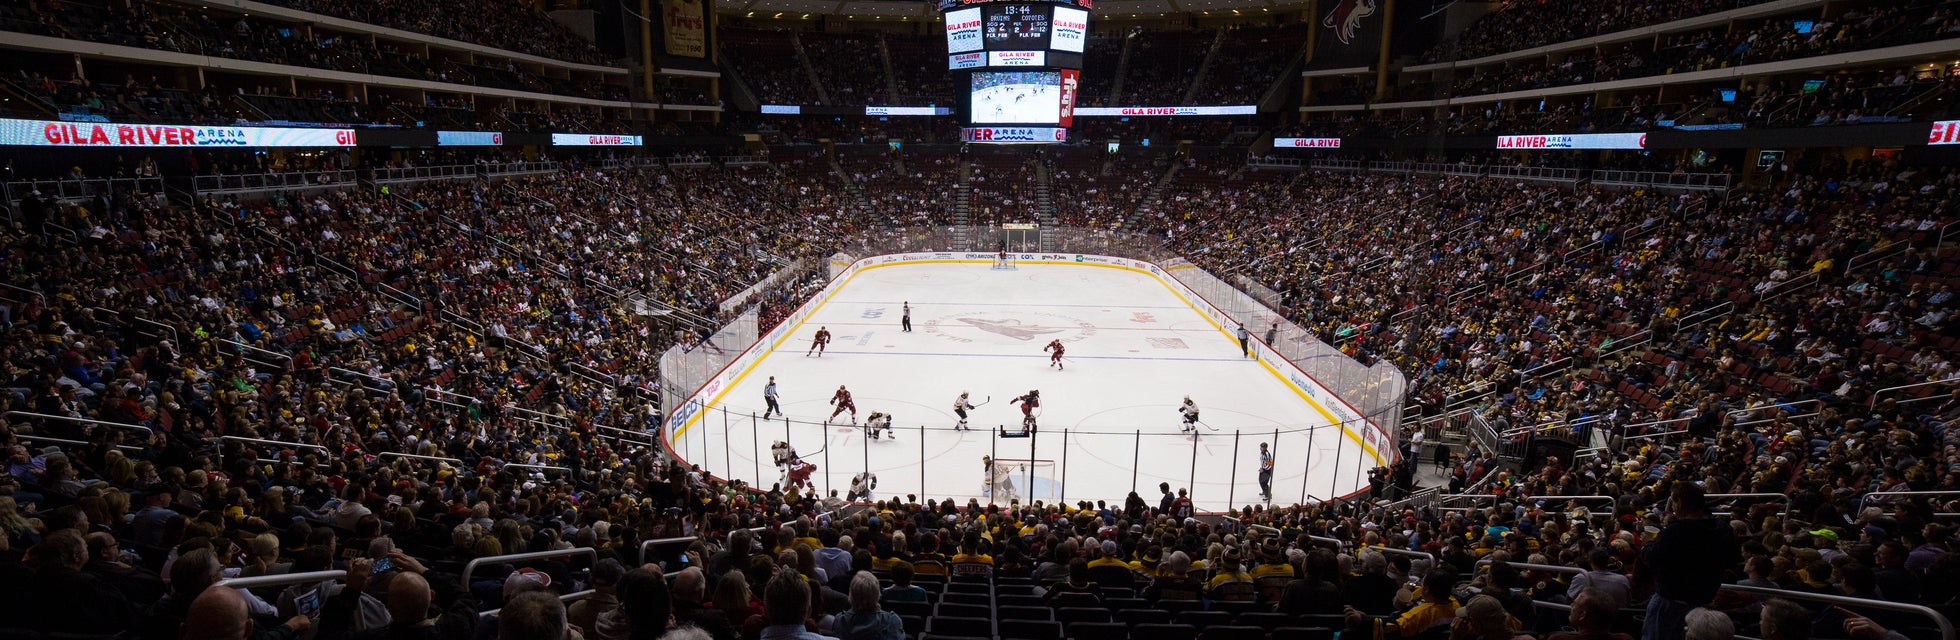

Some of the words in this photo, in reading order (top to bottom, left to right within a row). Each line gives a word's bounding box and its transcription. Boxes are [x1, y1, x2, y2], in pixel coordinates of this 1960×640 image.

[1005, 6, 1030, 15] 13:44
[947, 23, 961, 31] GILA
[962, 20, 981, 29] RIVER
[999, 23, 1005, 31] 2
[1067, 22, 1086, 30] RIVER
[952, 33, 976, 41] ARENA
[1146, 107, 1175, 115] RIVER
[44, 123, 111, 145] GILA
[118, 125, 196, 146] RIVER
[197, 128, 245, 138] ARENA
[589, 135, 603, 145] GILA
[604, 136, 621, 145] RIVER
[1295, 139, 1316, 147] GILA
[1318, 139, 1340, 147] RIVE
[1516, 136, 1546, 148] RIVER
[672, 399, 698, 431] GECO
